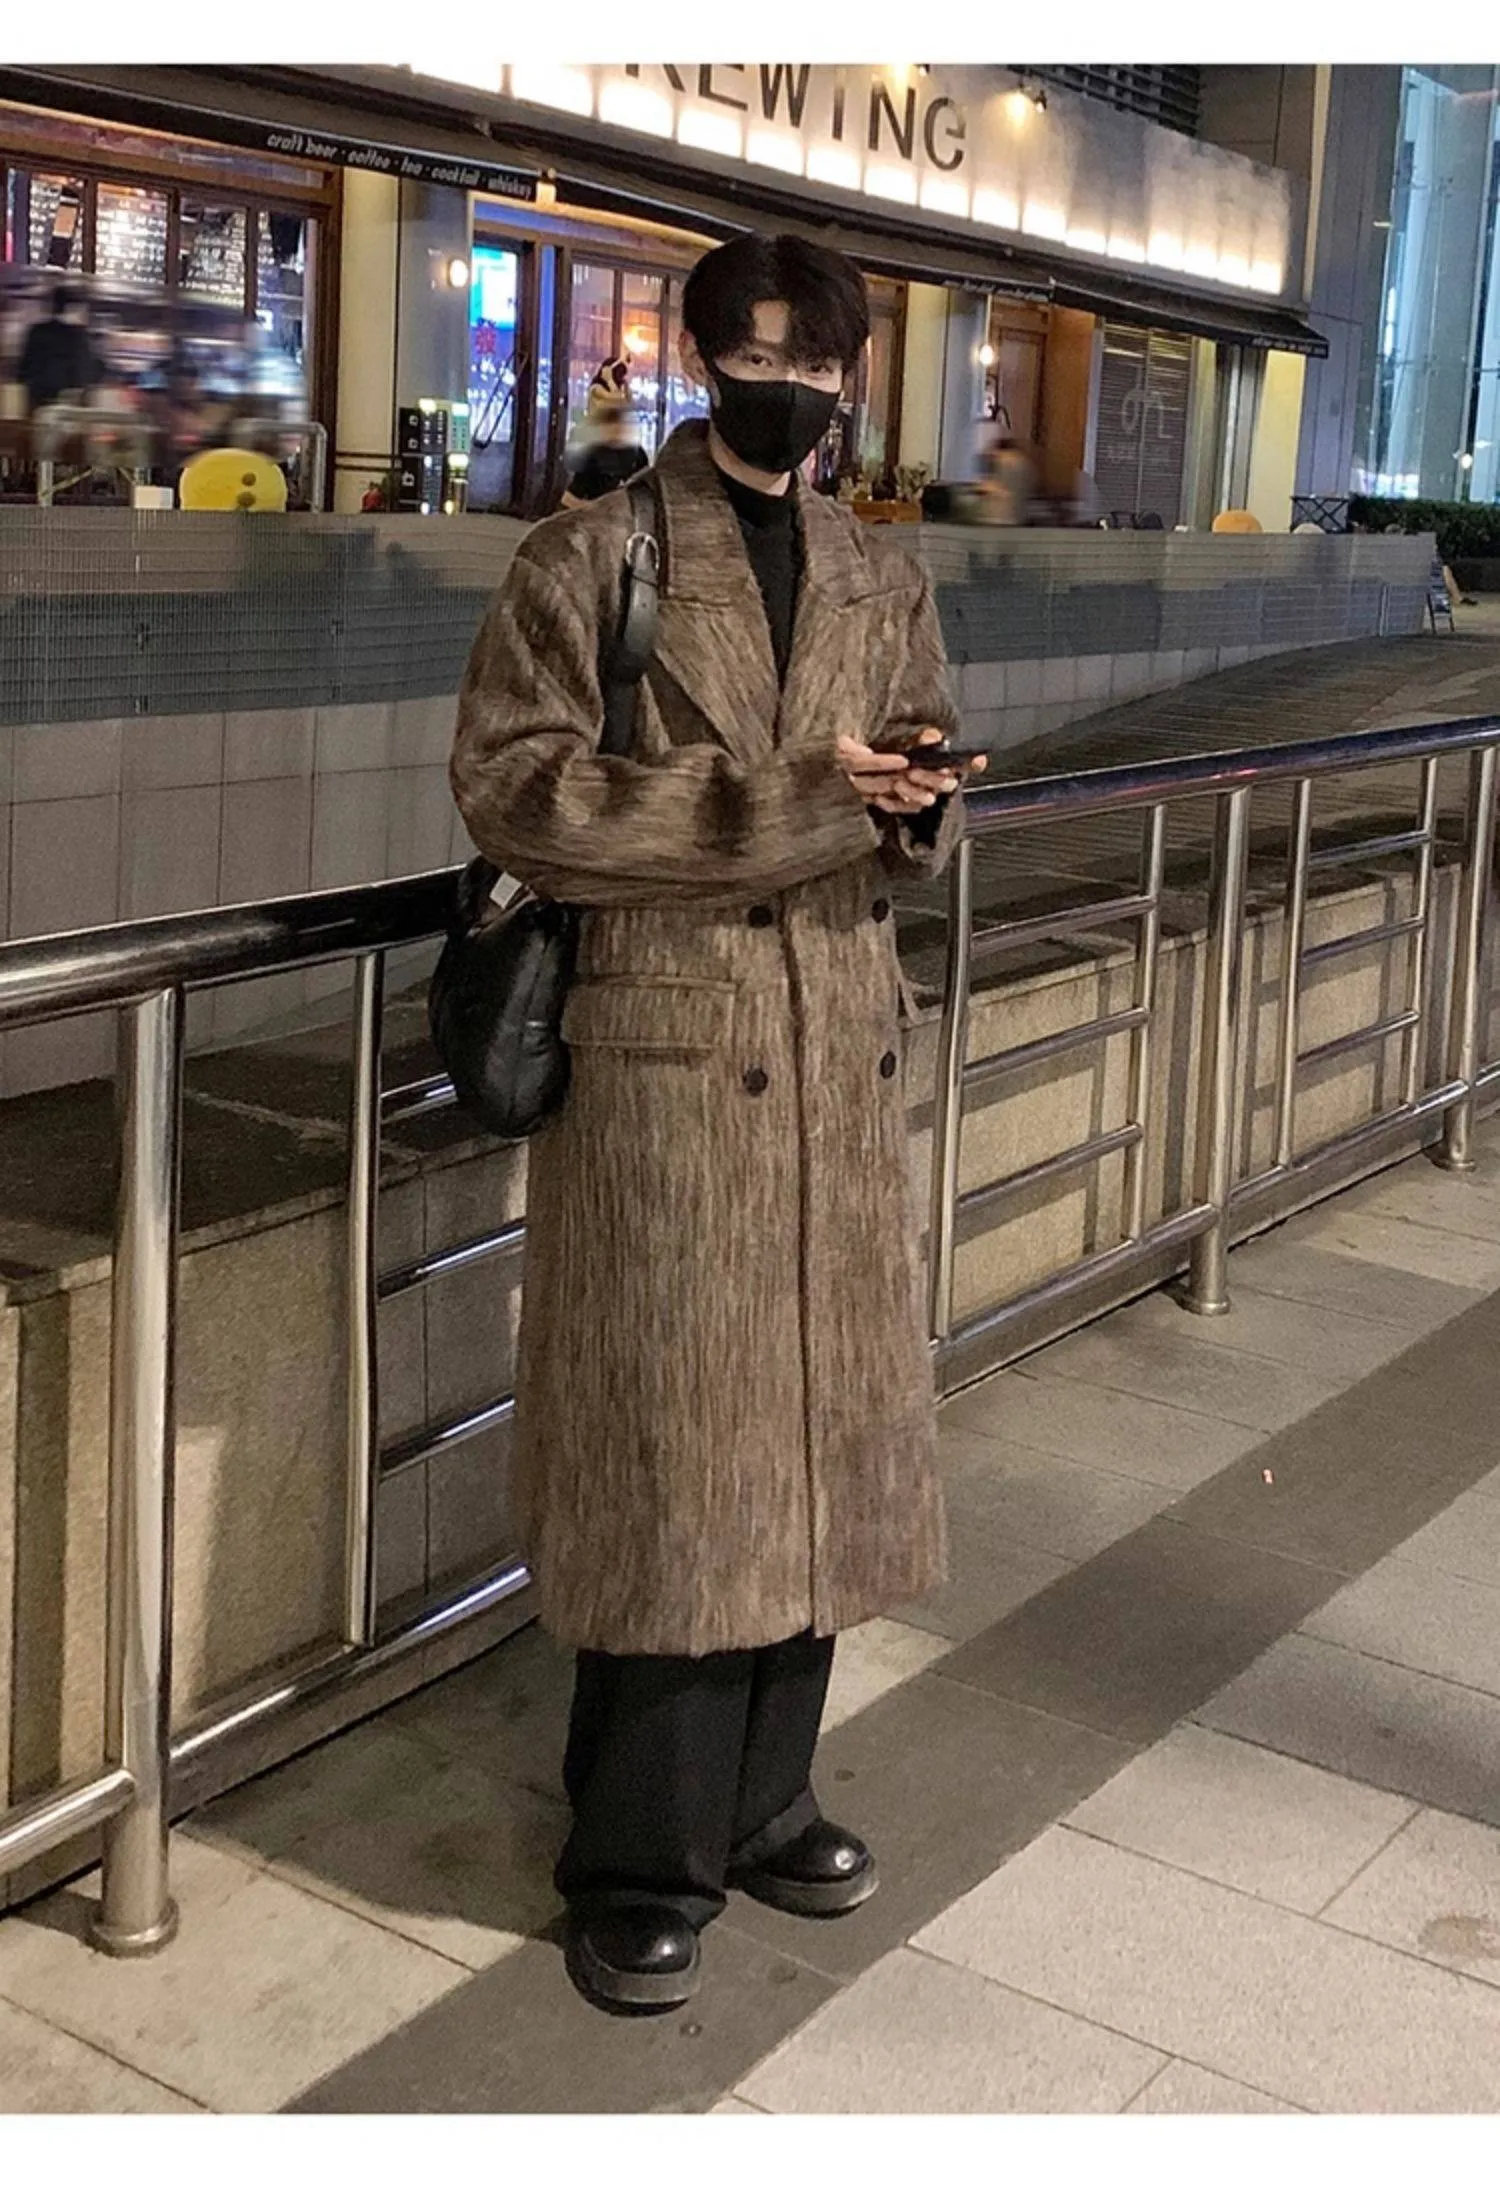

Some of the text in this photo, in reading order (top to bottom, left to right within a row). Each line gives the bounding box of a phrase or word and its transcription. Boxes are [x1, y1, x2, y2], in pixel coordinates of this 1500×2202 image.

[267, 133, 303, 152] craft
[305, 136, 337, 158] beer
[347, 147, 391, 169] coffee
[400, 155, 423, 176] tea
[431, 166, 480, 186] cocktail
